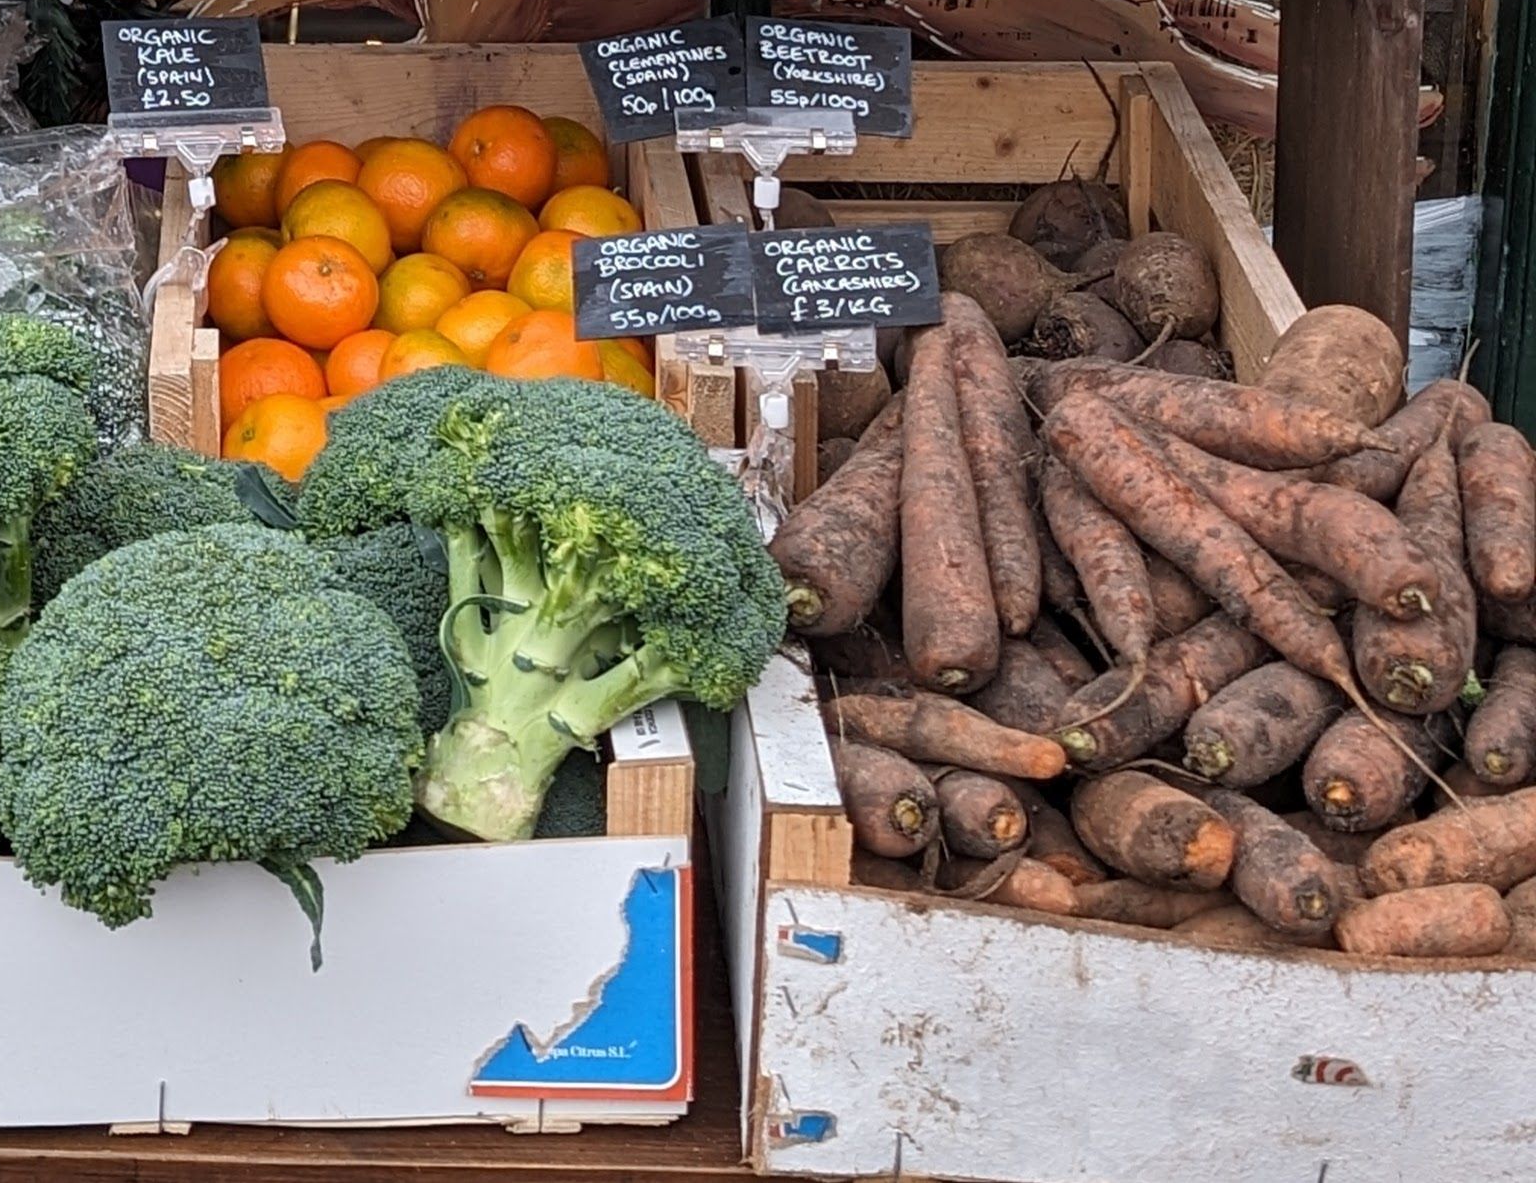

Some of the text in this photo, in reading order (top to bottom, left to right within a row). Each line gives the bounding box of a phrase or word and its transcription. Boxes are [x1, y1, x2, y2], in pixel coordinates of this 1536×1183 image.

[118, 27, 218, 47] ORGANIC
[597, 29, 686, 58] ORGANIC
[759, 24, 859, 52] ORGANIC
[137, 46, 201, 66] KALE
[608, 46, 728, 73] CLEMENTINES
[759, 39, 873, 72] BEETROOT
[137, 66, 215, 87] (SPAIN)
[612, 63, 691, 90] (SPAIN)
[773, 61, 885, 93] (YORKSHIRE)
[141, 88, 211, 109] £2.50
[770, 88, 870, 117] 55p/100g
[600, 233, 701, 255] ORGANIC
[764, 236, 876, 257] ORGANIC
[776, 252, 905, 276] CARROTS
[609, 275, 694, 304] (SPAIN)
[782, 270, 921, 296] (LANCASHIRE)
